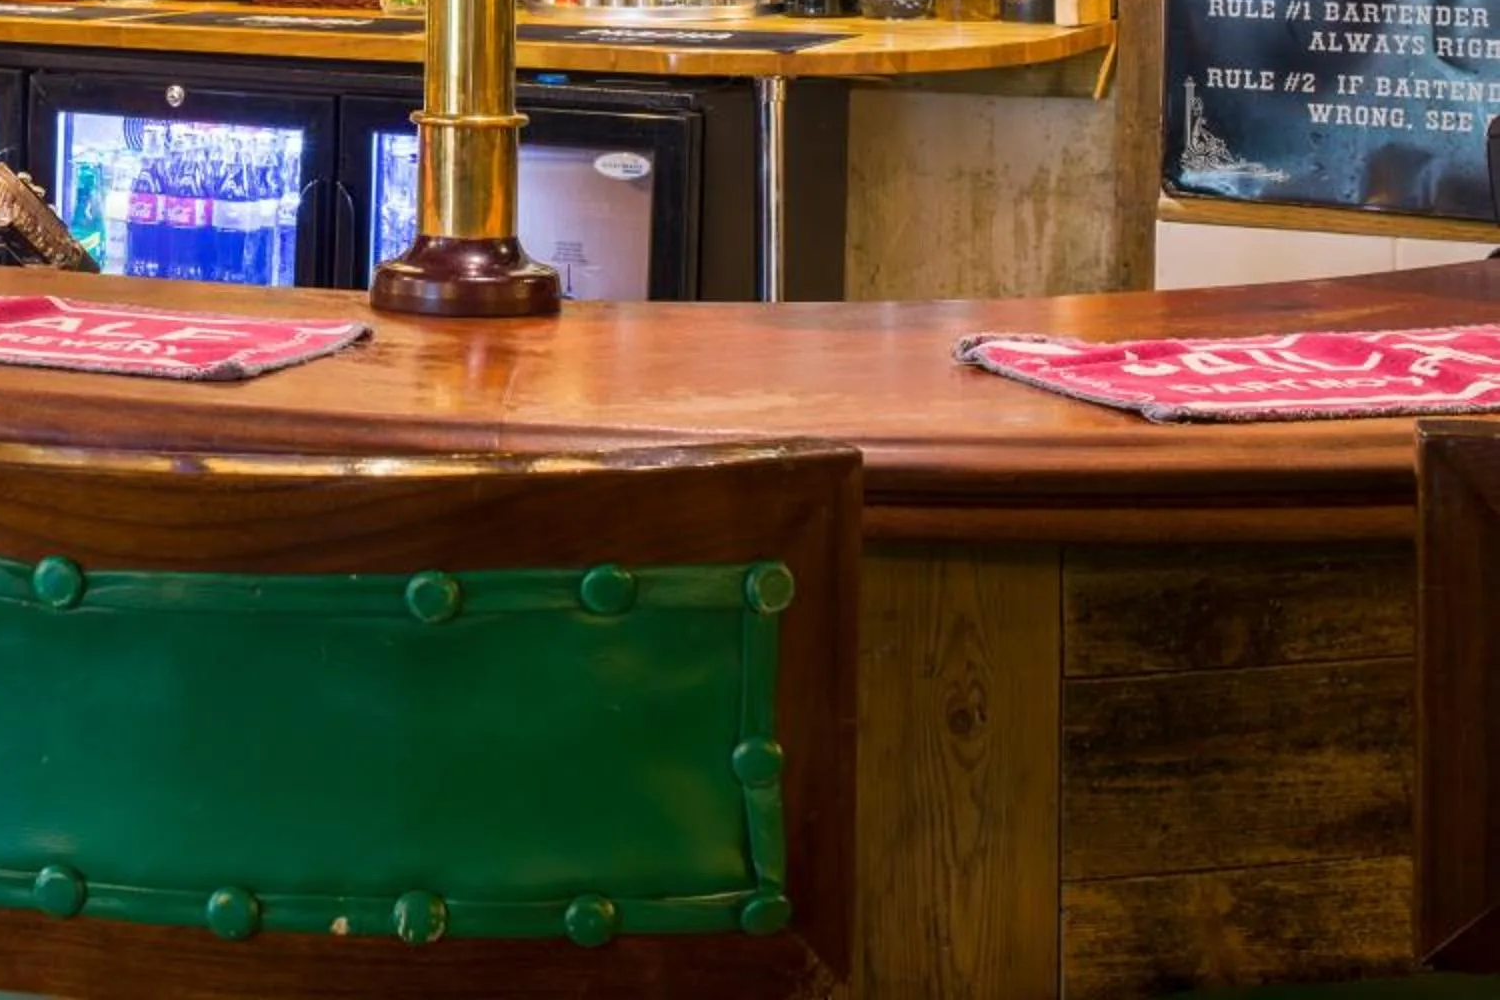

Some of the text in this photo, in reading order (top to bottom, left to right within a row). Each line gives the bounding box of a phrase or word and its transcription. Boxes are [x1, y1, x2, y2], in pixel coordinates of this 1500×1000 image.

[1285, 0, 1312, 22] #1
[1324, 2, 1489, 29] BARTENDER
[1308, 31, 1426, 56] ALWAYS
[1206, 67, 1275, 90] RULE
[1283, 72, 1317, 93] #2
[1337, 74, 1364, 95] IF
[1307, 102, 1474, 133] WRONG. SEE
